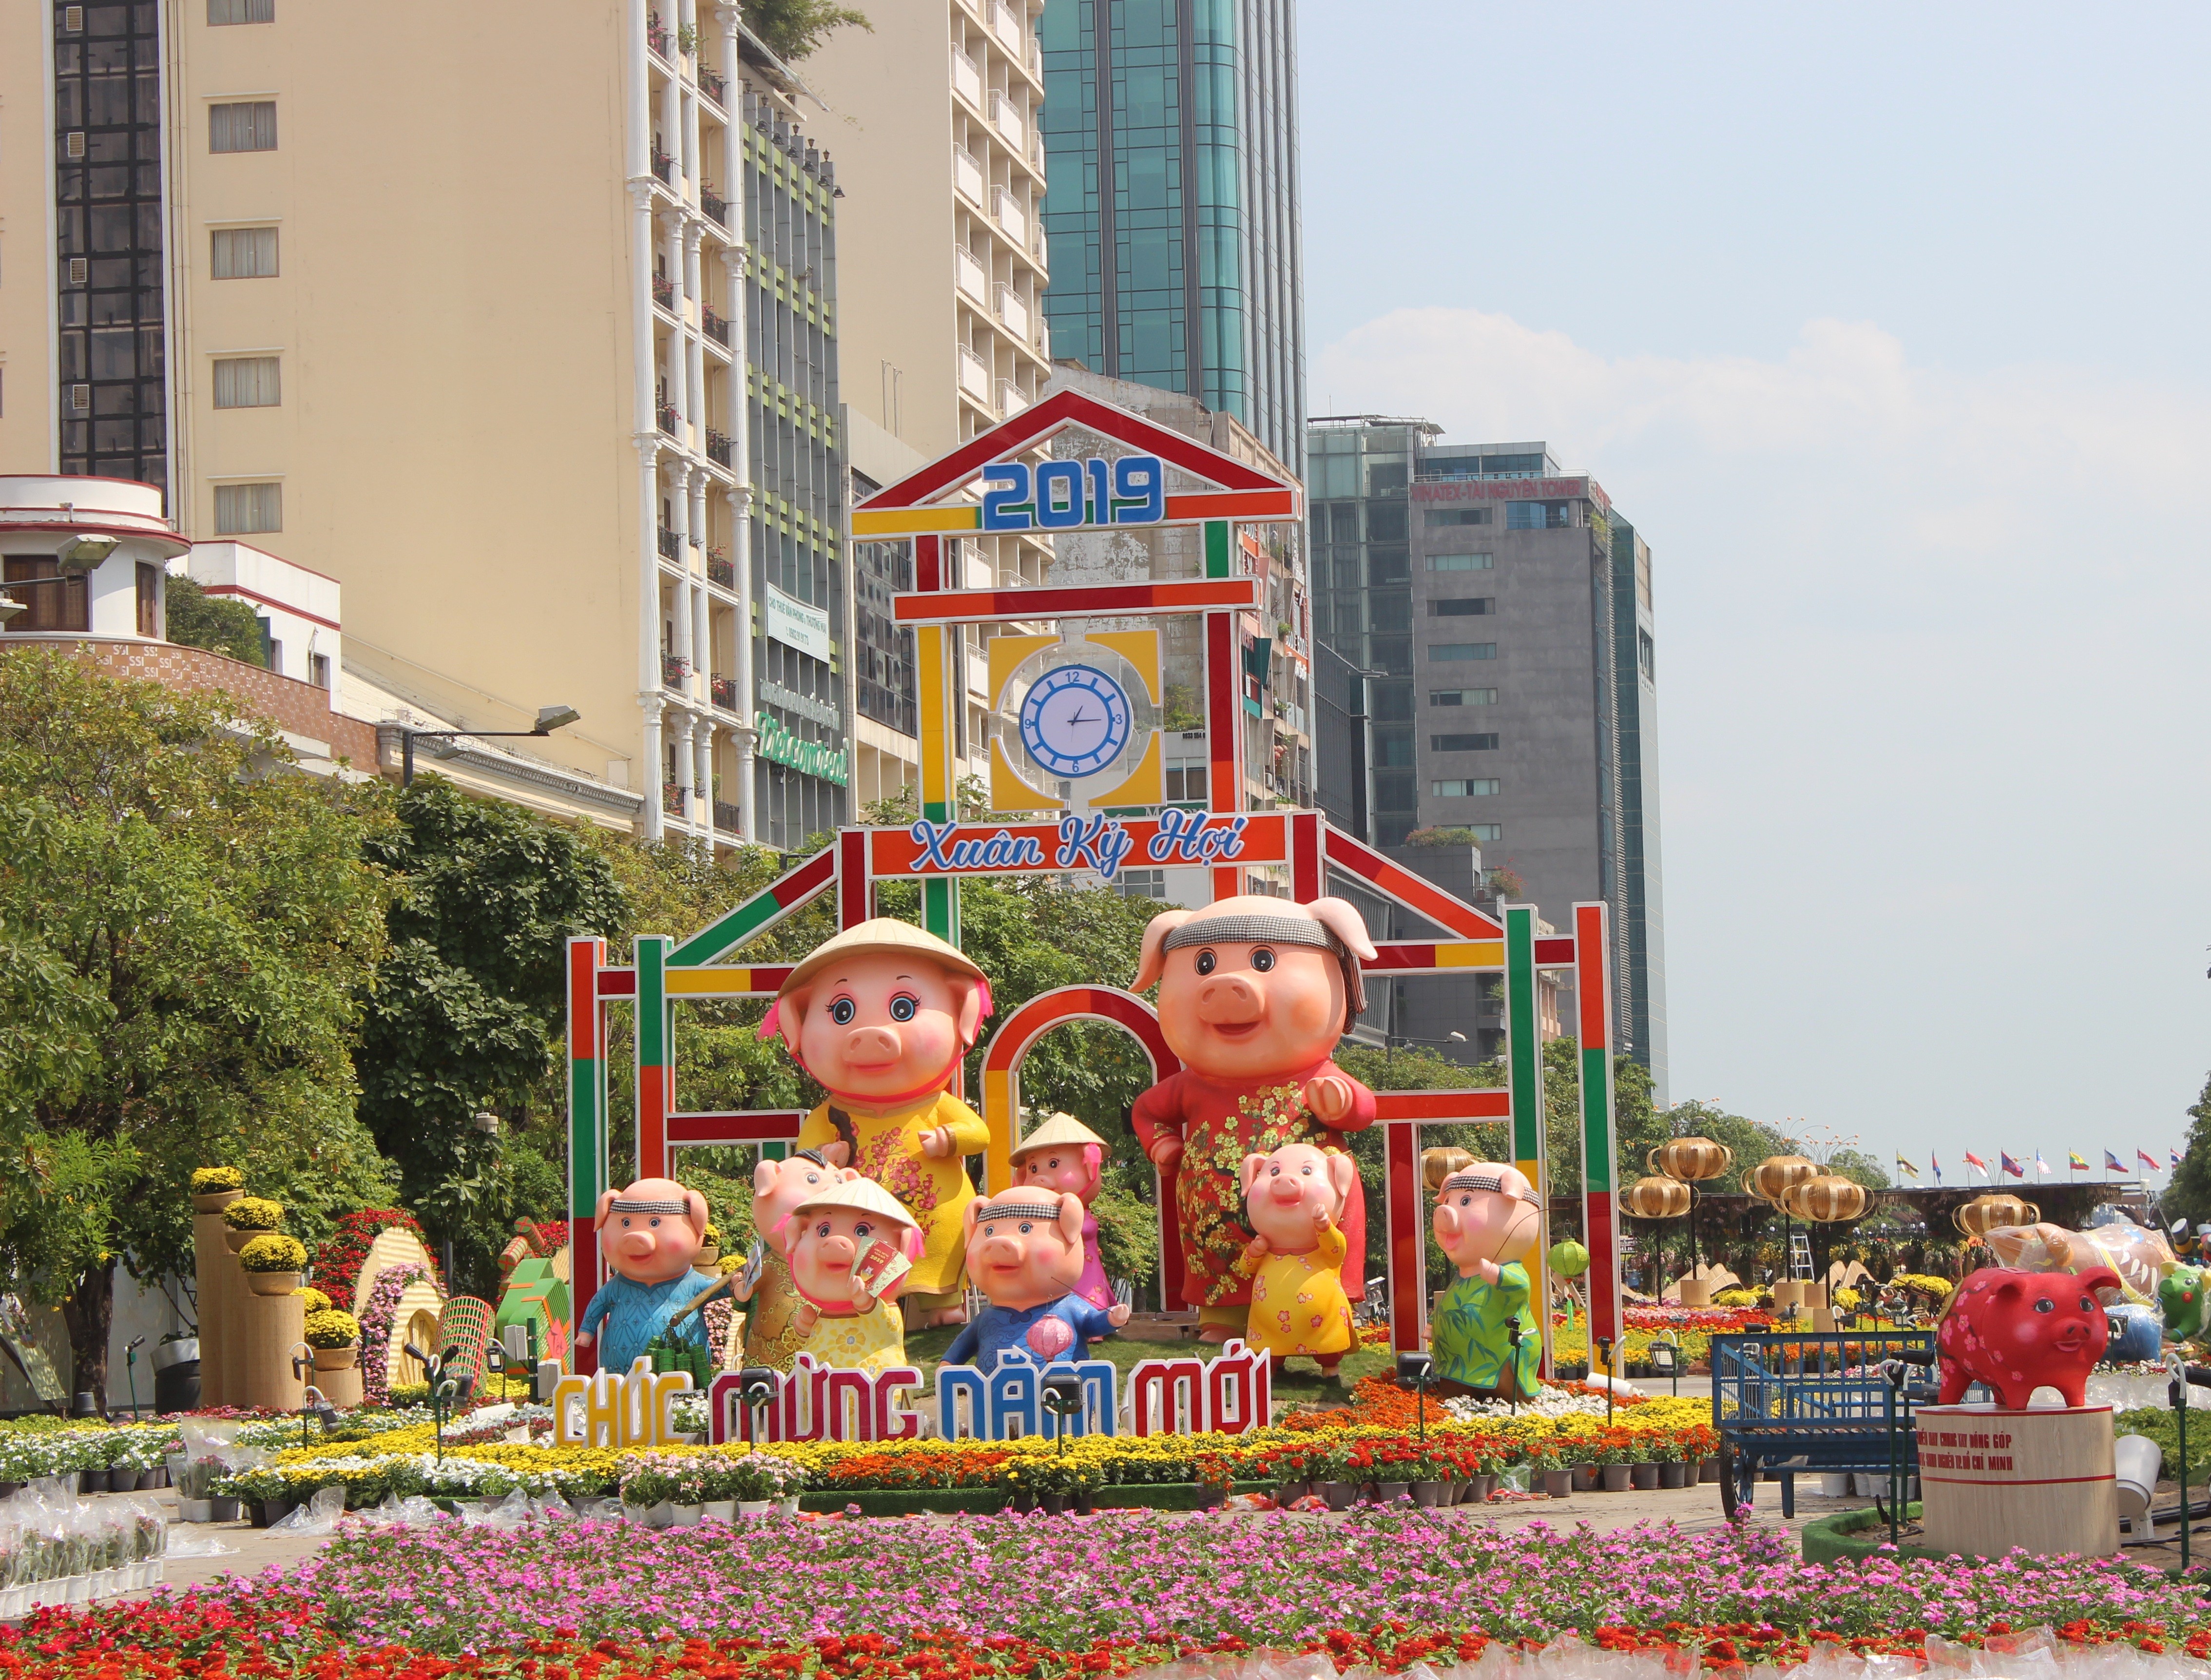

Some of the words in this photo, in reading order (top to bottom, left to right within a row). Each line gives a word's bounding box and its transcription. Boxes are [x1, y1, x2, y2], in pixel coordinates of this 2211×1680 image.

[981, 455, 1165, 531] 2019
[1488, 478, 1539, 499] NGUYÊN
[1541, 479, 1581, 497] TOWER
[776, 600, 785, 615] THUÊ
[792, 607, 804, 624] PHÒNG
[129, 656, 144, 666] SSI
[159, 657, 172, 668] SSI
[144, 667, 158, 677] SSI
[1065, 672, 1079, 682] 12
[1025, 719, 1032, 729] 9
[1115, 714, 1122, 725] 3
[754, 711, 849, 788] Vietcombank
[1072, 763, 1079, 773] 6
[909, 819, 1045, 871] Xuân
[1055, 811, 1134, 879] Kỷ
[1148, 807, 1249, 868] Hợi
[870, 1255, 884, 1264] 2019
[553, 1356, 694, 1448] CHÚC
[708, 1352, 924, 1446] MỪNG
[935, 1345, 1118, 1443] NĂM
[1128, 1338, 1271, 1438] MỚI
[1969, 1431, 1989, 1448] ĐÓNG
[1993, 1430, 2012, 1448] GÓP
[1972, 1452, 1983, 1470] CHÍ
[1988, 1456, 2013, 1470] MINH
